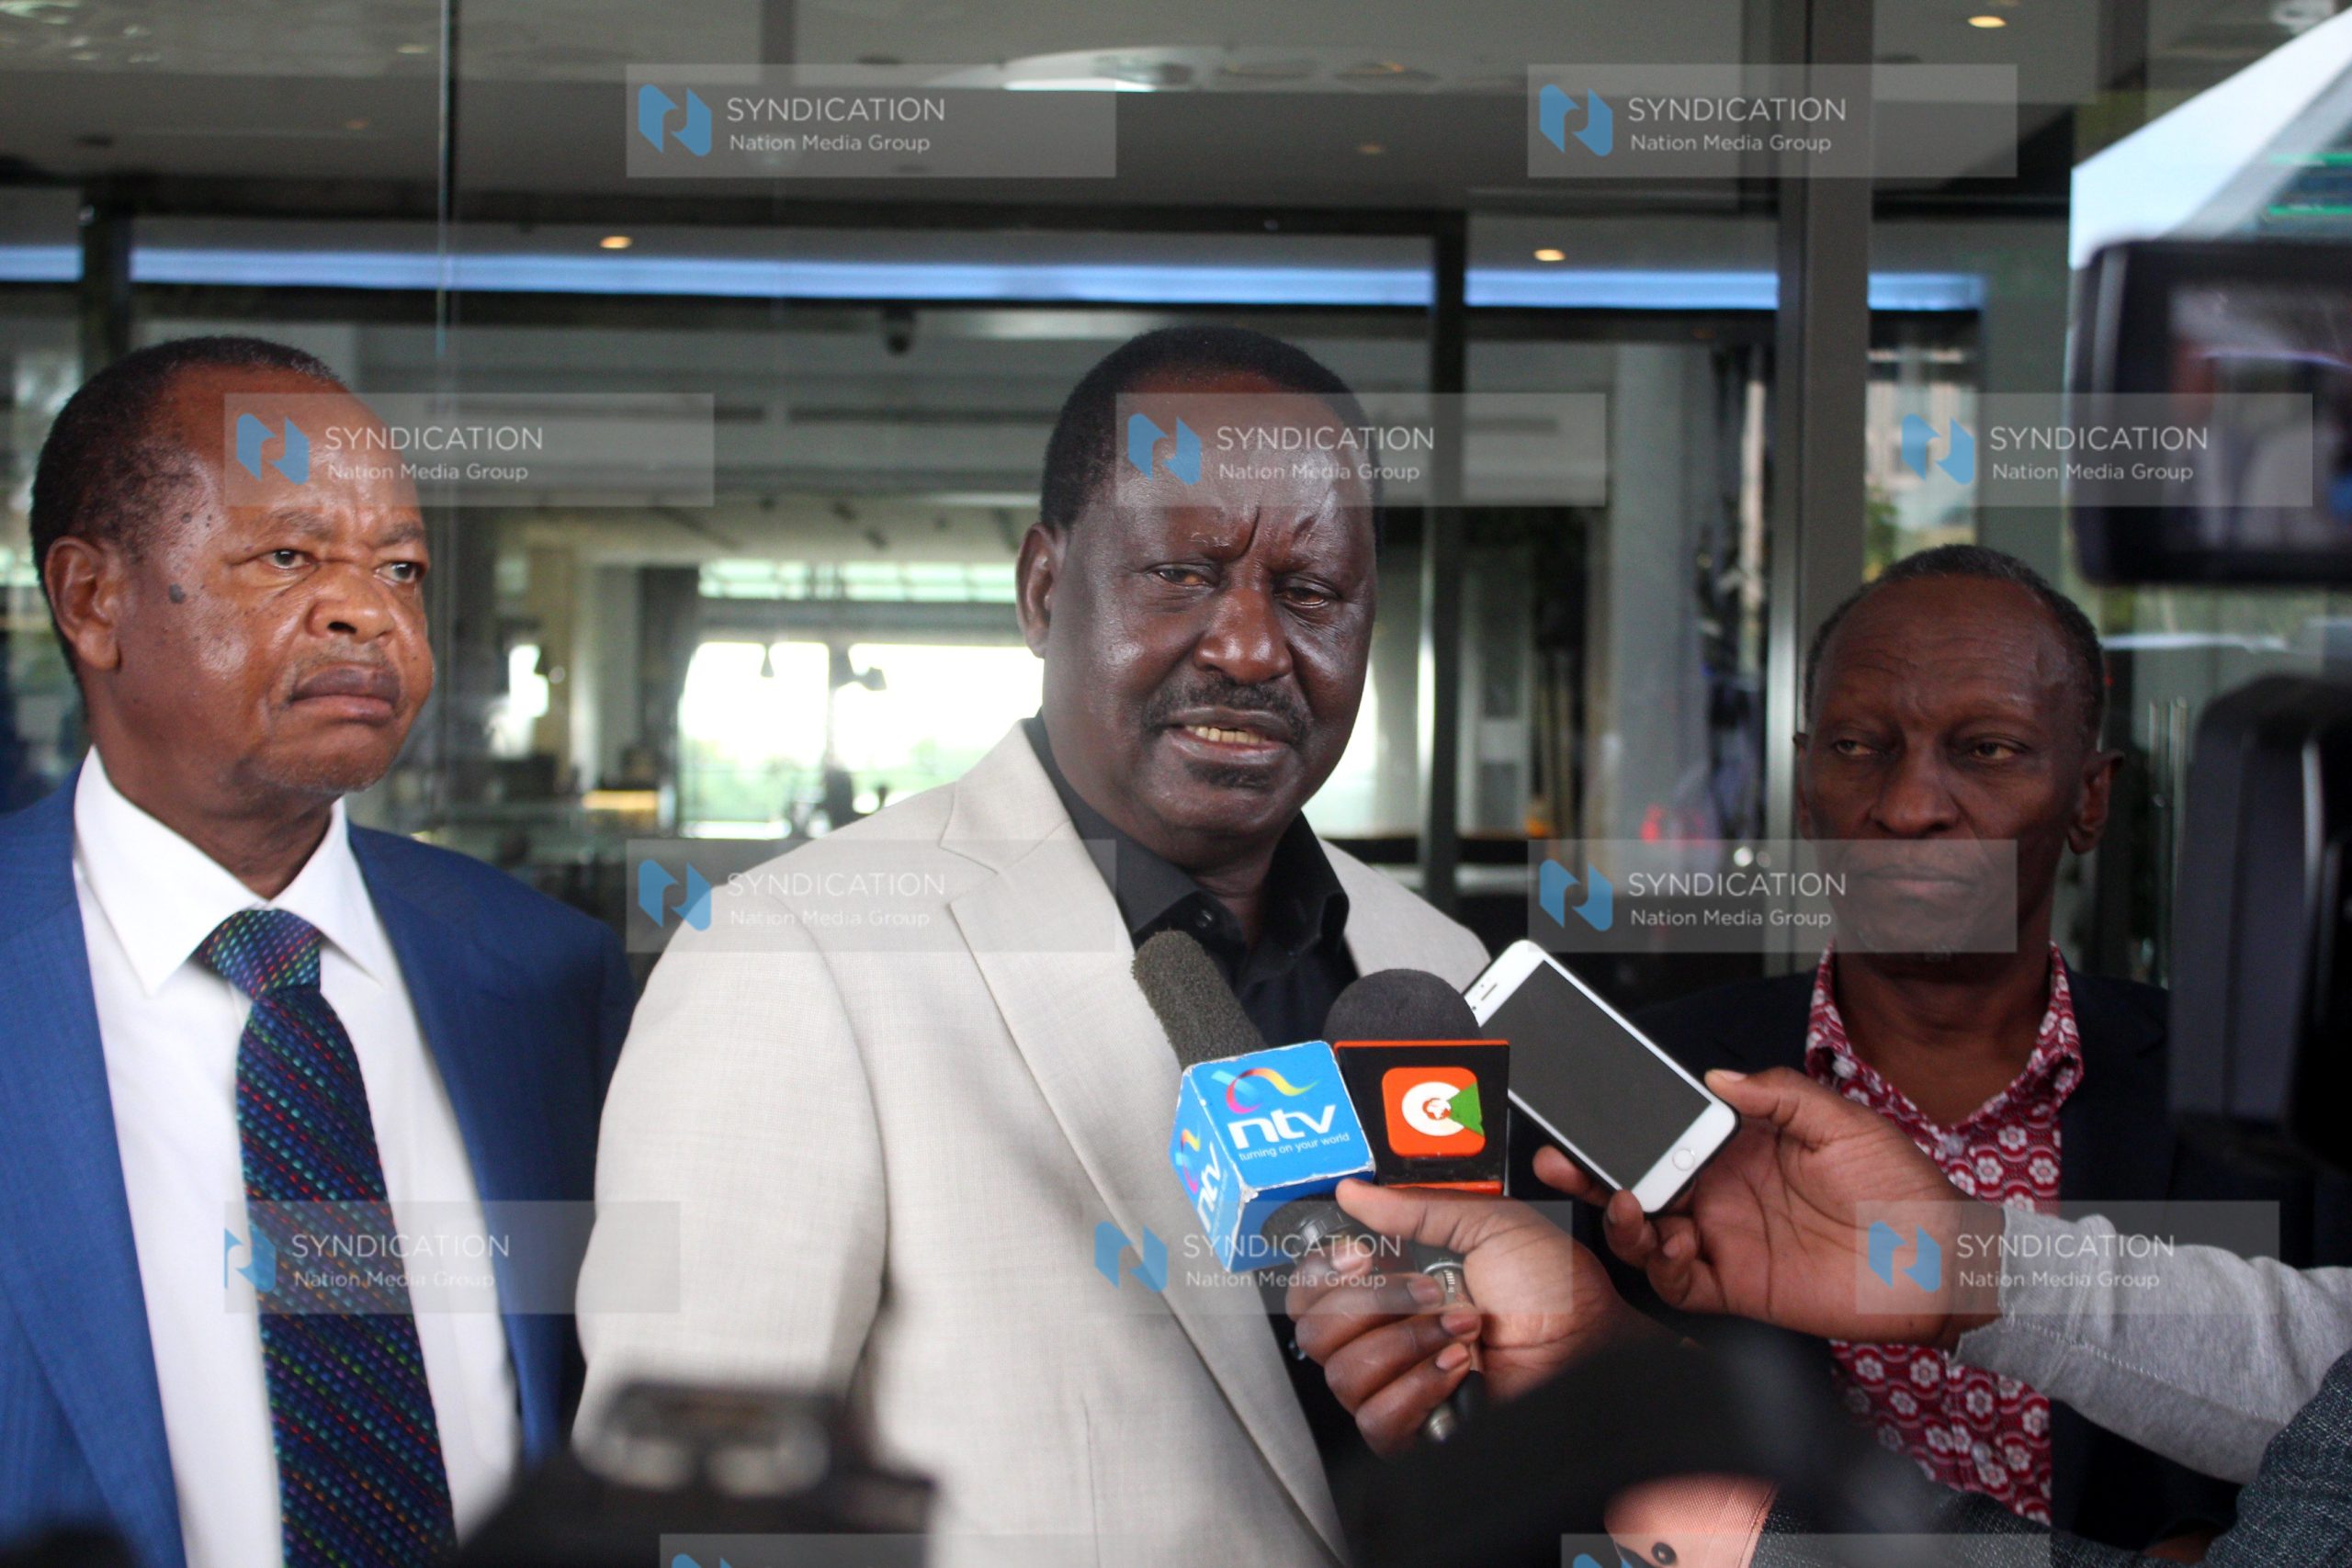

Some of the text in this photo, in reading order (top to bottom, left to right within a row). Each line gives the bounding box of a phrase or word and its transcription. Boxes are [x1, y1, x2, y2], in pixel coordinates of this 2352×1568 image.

[1227, 1105, 1336, 1149] ntv
[1238, 1132, 1350, 1161] turning on your world
[1197, 1141, 1221, 1233] ntv
